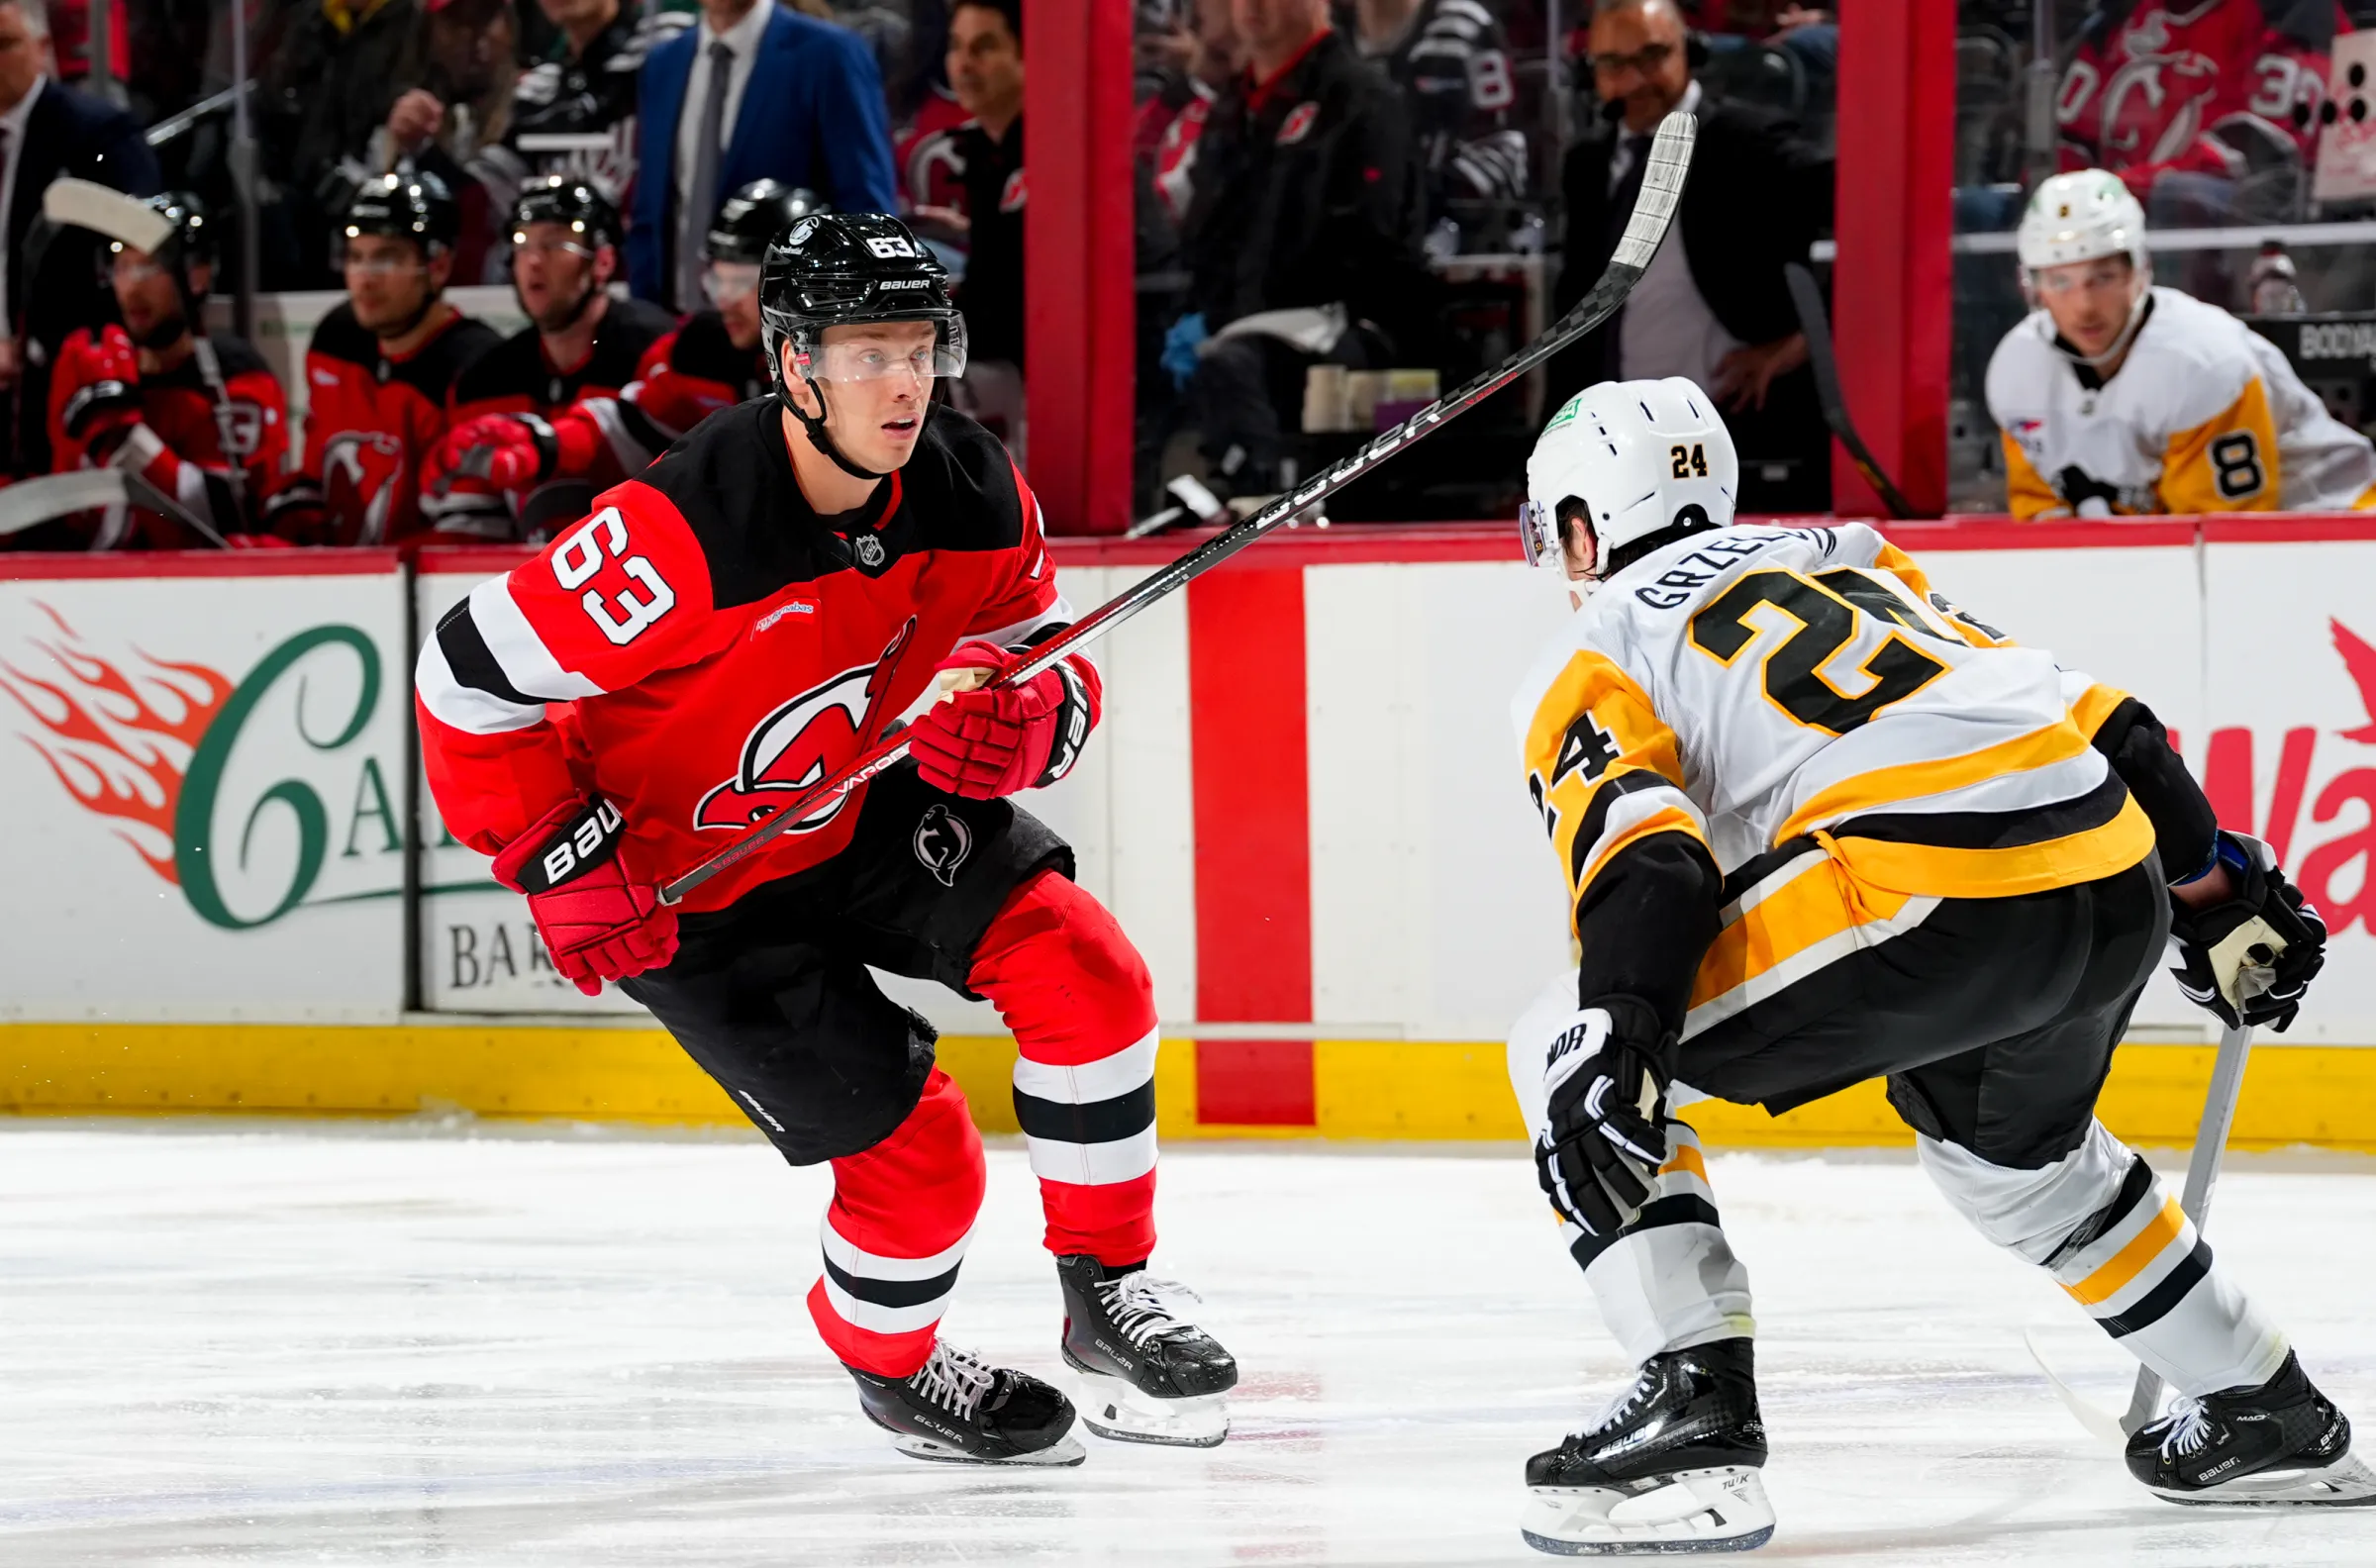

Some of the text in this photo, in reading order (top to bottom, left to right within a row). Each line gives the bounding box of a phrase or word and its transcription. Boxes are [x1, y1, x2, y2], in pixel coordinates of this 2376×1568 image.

[866, 234, 916, 259] 63
[880, 279, 931, 291] BAUER
[1670, 442, 1709, 480] 24
[2208, 430, 2266, 501] 8
[550, 506, 676, 646] 63
